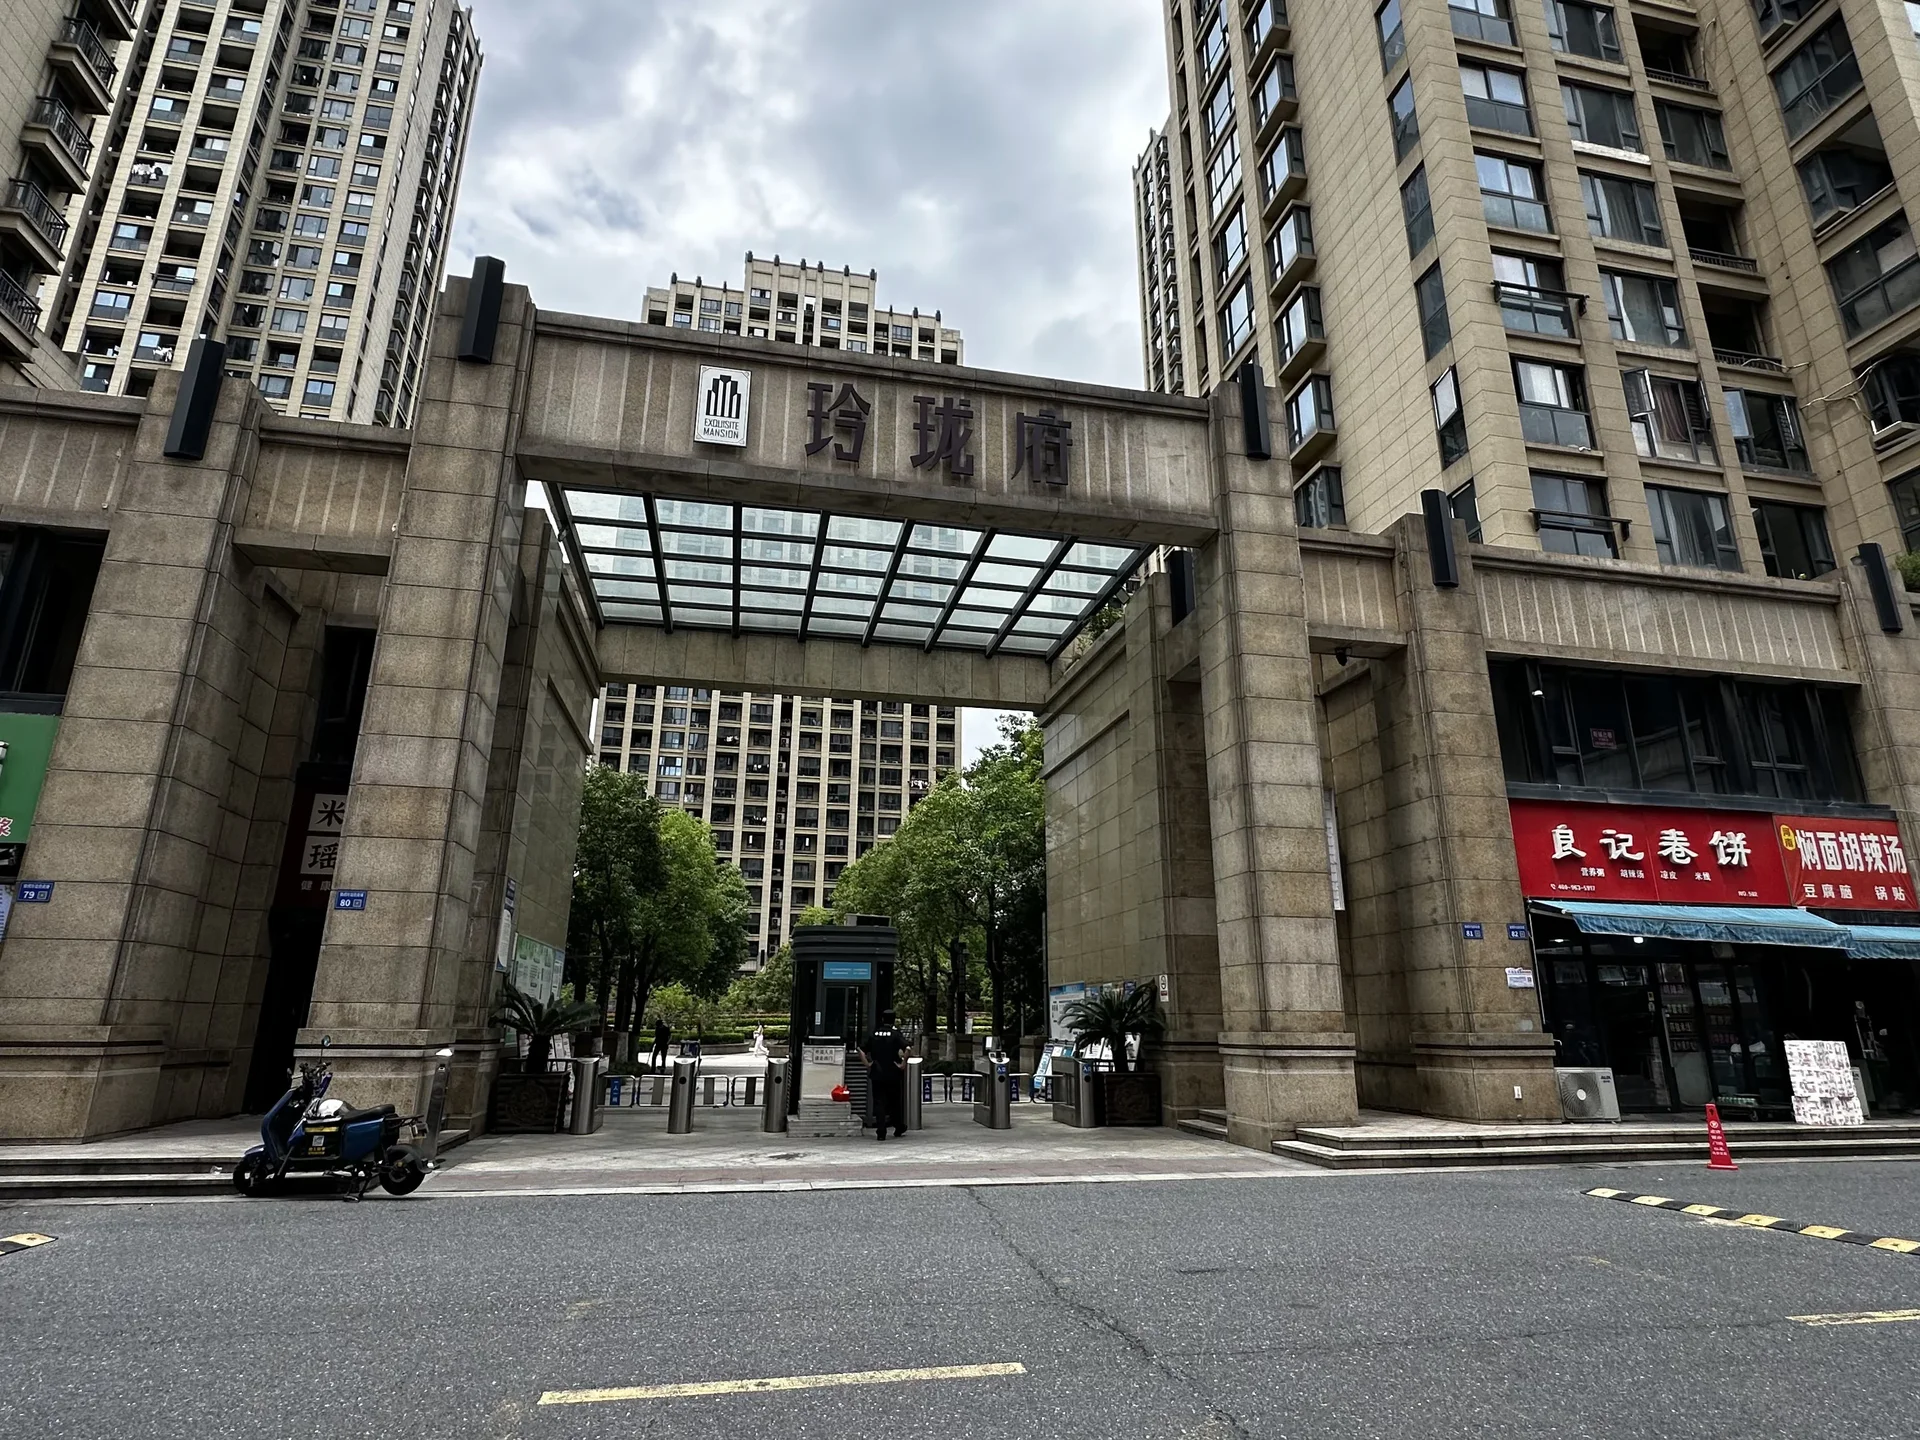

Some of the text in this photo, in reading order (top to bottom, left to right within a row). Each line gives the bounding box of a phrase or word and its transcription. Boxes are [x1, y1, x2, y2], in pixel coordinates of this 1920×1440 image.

[704, 418, 739, 430] EXQUISITE
[703, 428, 739, 439] MANSION
[805, 383, 1072, 485] 玲珑府
[1551, 824, 1751, 867] 良记卷饼
[1795, 829, 1907, 873] 焖面胡辣汤
[23, 891, 35, 899] 79
[1874, 886, 1906, 901] 锅贴
[340, 899, 350, 907] 80
